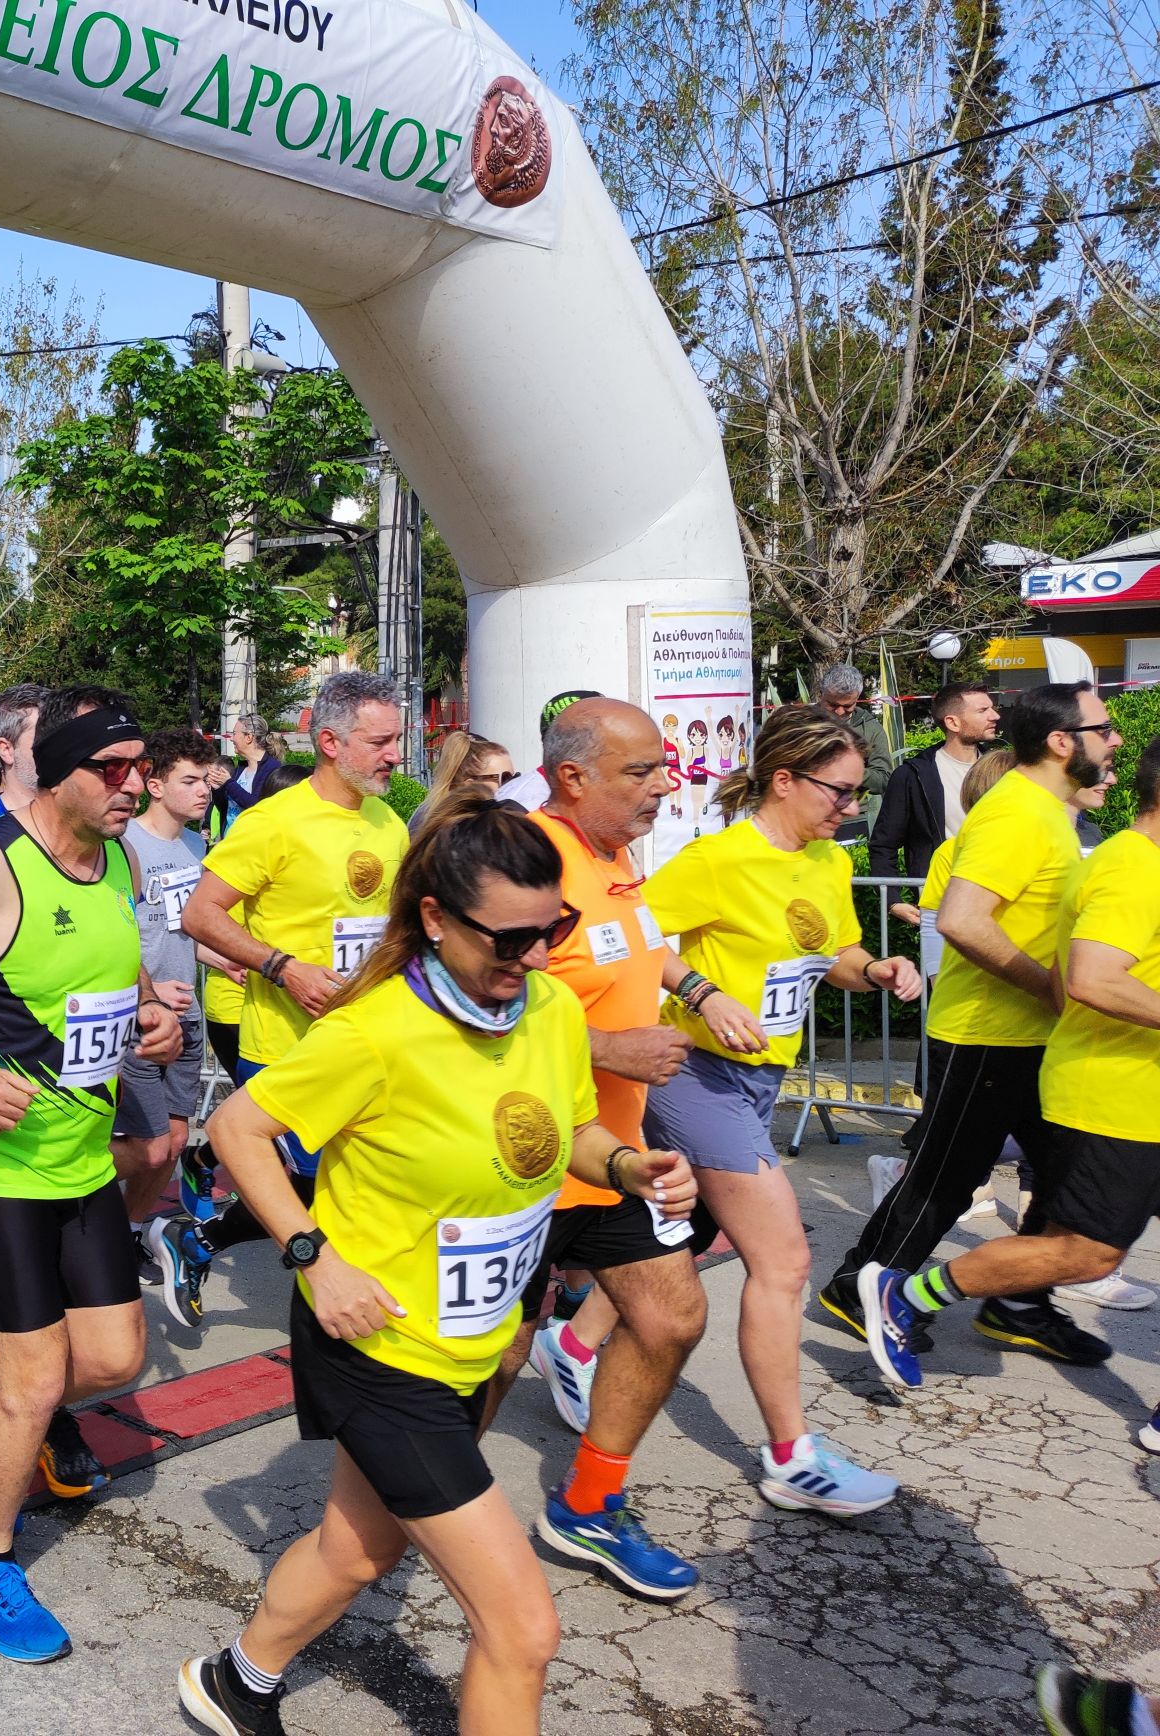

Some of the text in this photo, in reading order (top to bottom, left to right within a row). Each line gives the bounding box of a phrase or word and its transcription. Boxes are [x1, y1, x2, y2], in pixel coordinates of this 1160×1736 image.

[192, 0, 333, 51] ΕΙΟΥ
[181, 54, 463, 193] ΔΡΟΜΟΣ
[1028, 570, 1122, 594] EKO
[652, 629, 714, 643] Διεύθυνση
[653, 647, 720, 663] Αθλητισμού
[721, 647, 728, 659] &
[654, 667, 693, 682] Τμήμα
[68, 1017, 134, 1066] 1514
[446, 1227, 545, 1308] 1361
